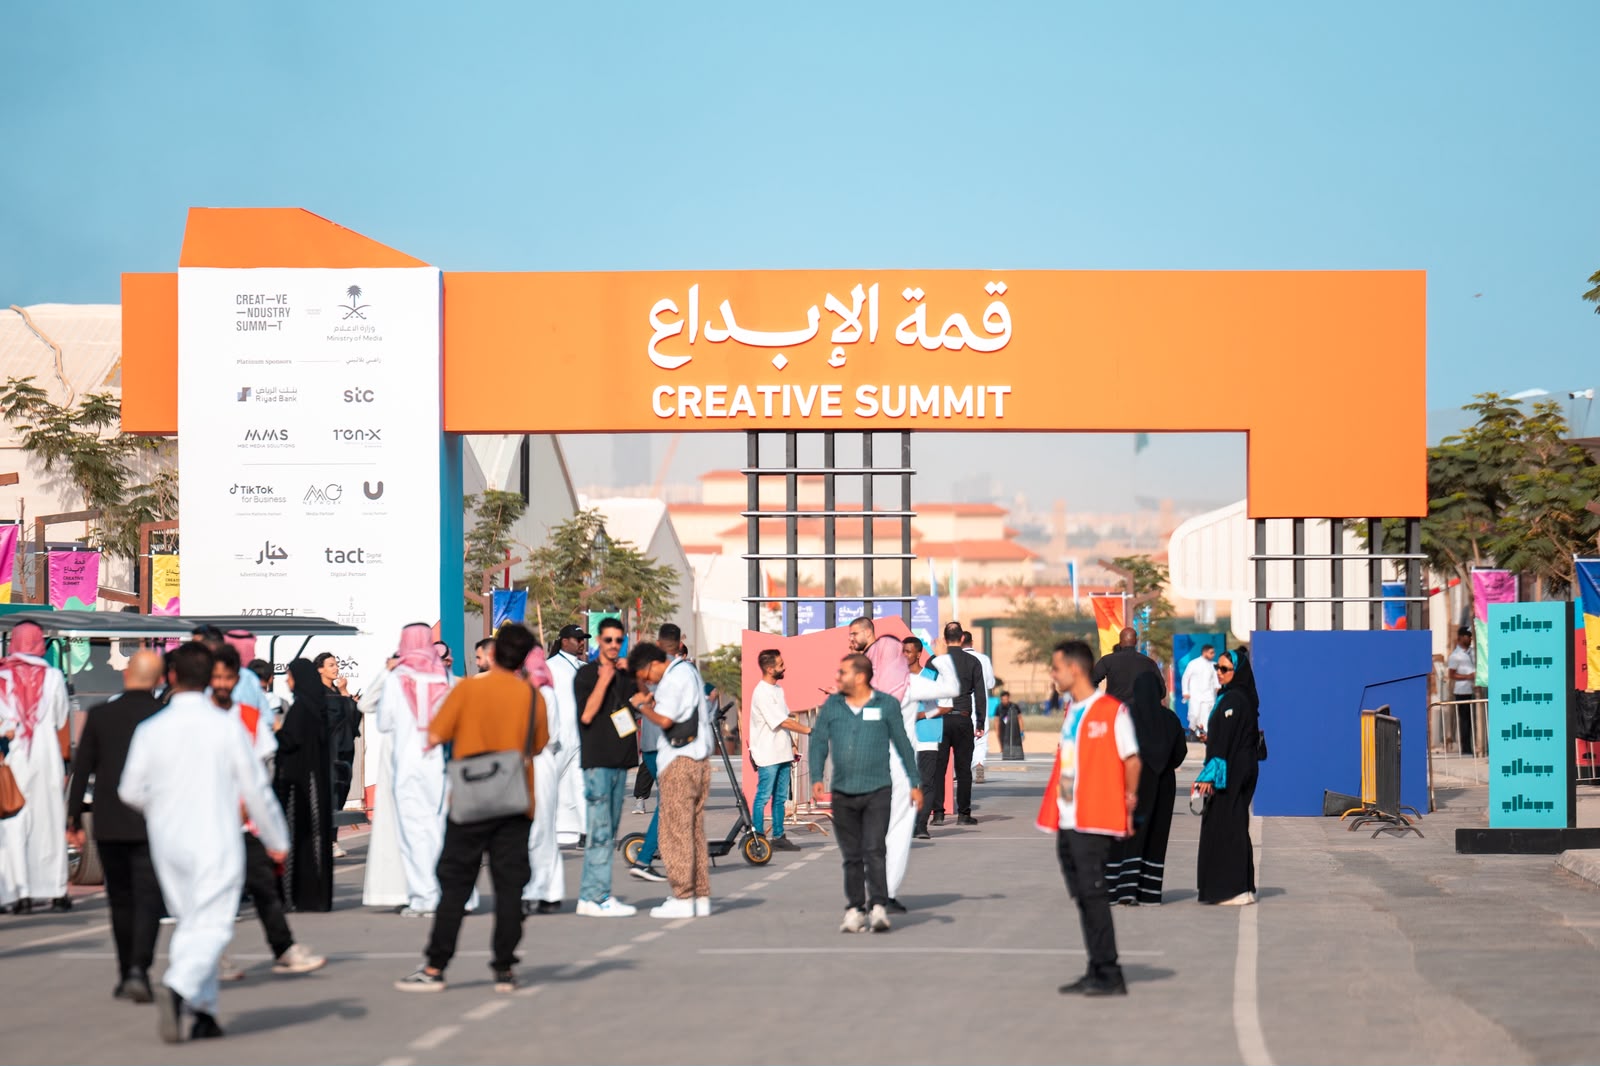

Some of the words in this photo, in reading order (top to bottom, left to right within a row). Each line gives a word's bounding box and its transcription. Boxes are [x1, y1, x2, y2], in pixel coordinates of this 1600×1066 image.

[896, 281, 1013, 352] قمة
[648, 282, 879, 370] الإبداع
[326, 334, 354, 343] Ministry
[354, 334, 362, 342] of
[256, 395, 277, 404] Riyad
[278, 395, 297, 403] Bank
[344, 387, 375, 404] stc
[652, 385, 843, 418] CREATIVE
[855, 385, 1012, 418] SUMMIT
[240, 485, 274, 495] TikTok
[242, 495, 252, 503] for
[253, 495, 287, 504] Business
[325, 548, 364, 564] tact
